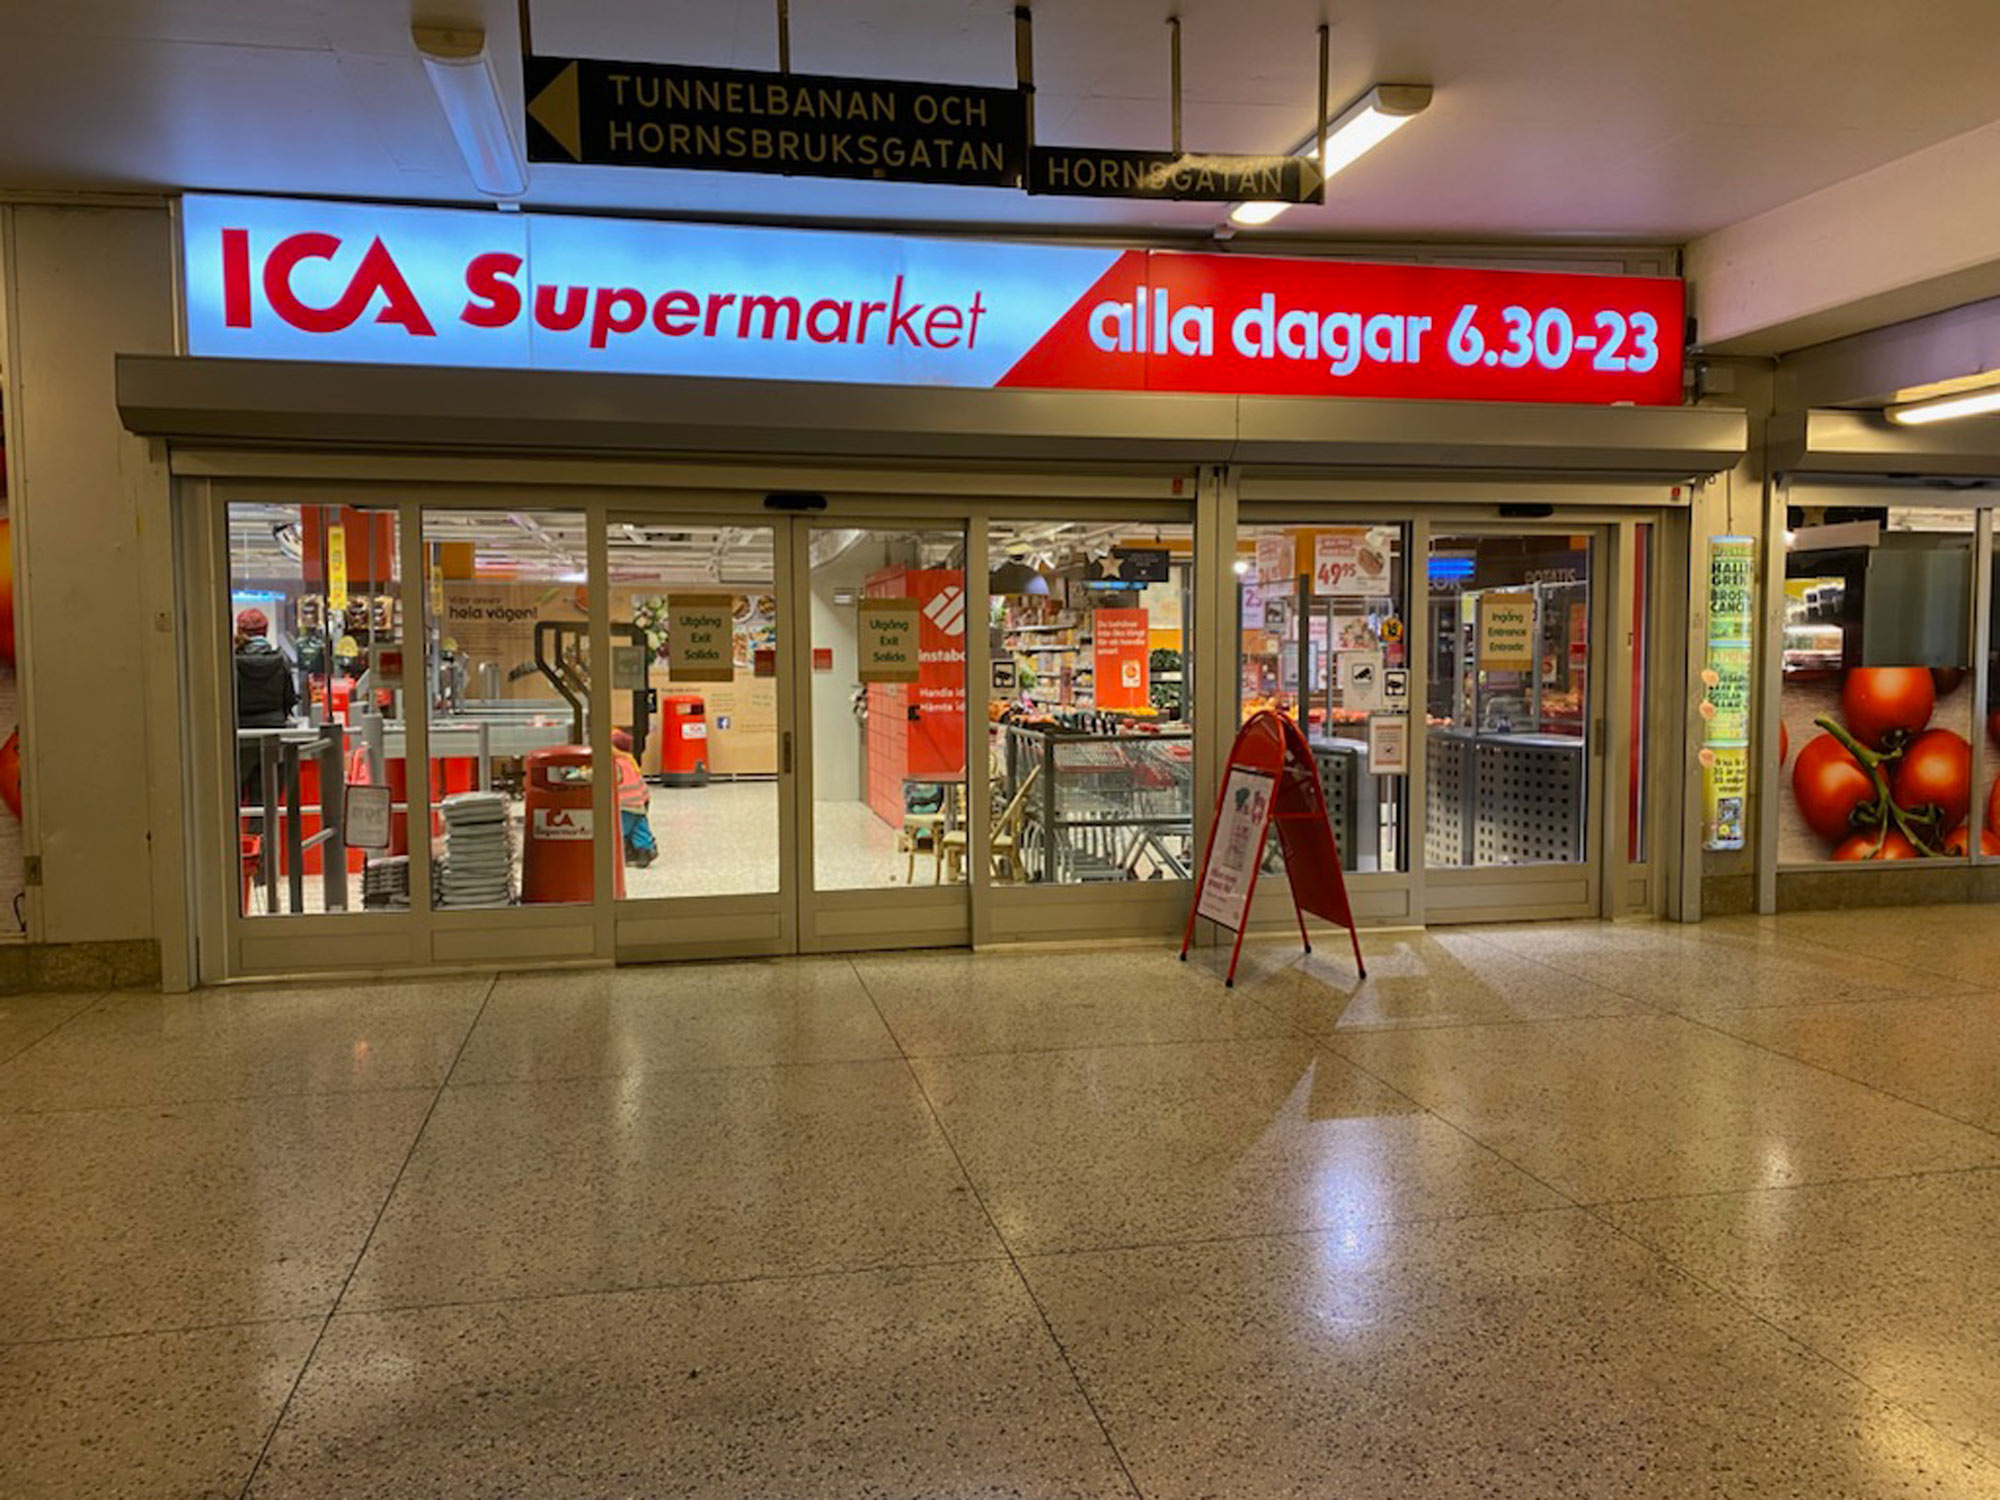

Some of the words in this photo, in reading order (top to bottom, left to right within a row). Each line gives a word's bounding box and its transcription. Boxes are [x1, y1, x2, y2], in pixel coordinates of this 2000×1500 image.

[608, 75, 896, 122] TUNNELBANAN
[913, 95, 987, 127] OCH
[609, 120, 1004, 171] HORNSBRUKSGATAN
[1049, 157, 1284, 193] HORNSGATAN
[221, 227, 437, 337] ICA
[459, 251, 987, 349] Supermarket
[1088, 286, 1214, 356] alla
[1231, 293, 1432, 376] dagar
[1446, 303, 1660, 374] 6.30-23
[449, 606, 483, 619] hela
[487, 606, 538, 622] vägen!
[679, 614, 721, 629] Utgång
[1492, 611, 1523, 624] Ingång
[870, 620, 909, 632] Utgång
[1488, 628, 1527, 637] Entrance
[691, 632, 711, 643] Exit
[880, 636, 899, 646] Exit
[685, 649, 719, 660] Salida
[546, 810, 574, 827] ICA
